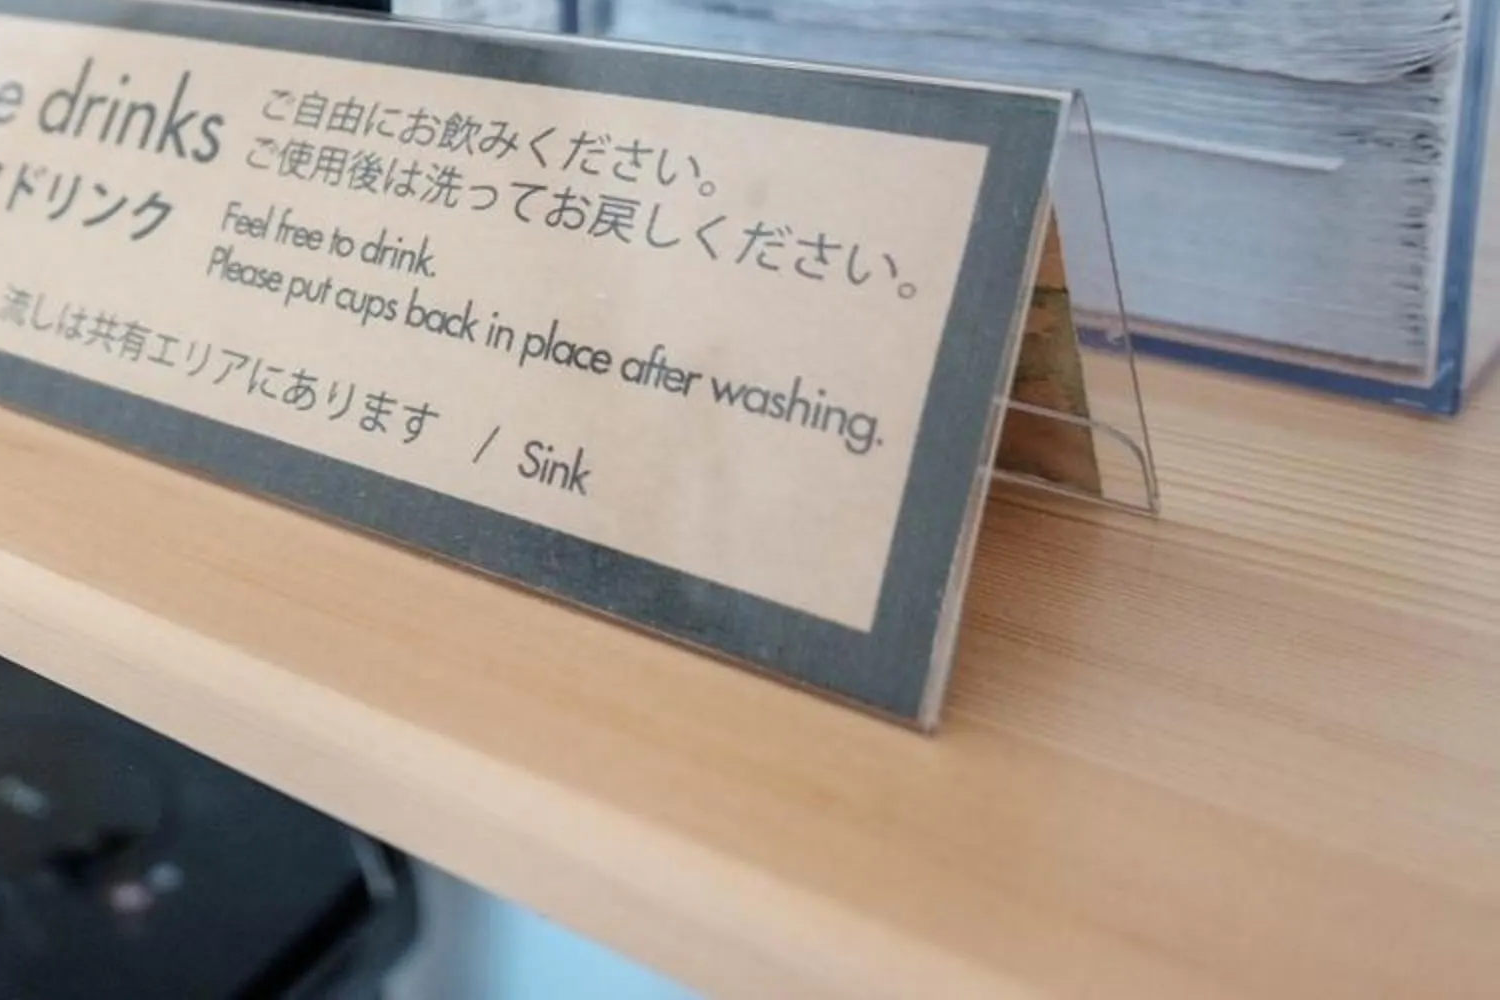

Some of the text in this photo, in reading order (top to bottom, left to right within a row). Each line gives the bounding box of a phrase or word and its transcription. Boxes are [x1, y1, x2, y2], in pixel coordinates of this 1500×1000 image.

[37, 57, 226, 164] drinks
[260, 88, 718, 198] ご自由にお飲みください。
[221, 202, 437, 278] Feel free to drink.
[245, 135, 917, 300] ご使用後は洗ってお戻しください。
[207, 246, 885, 456] Please put cups back in place after washing.
[516, 440, 592, 496] Sink
